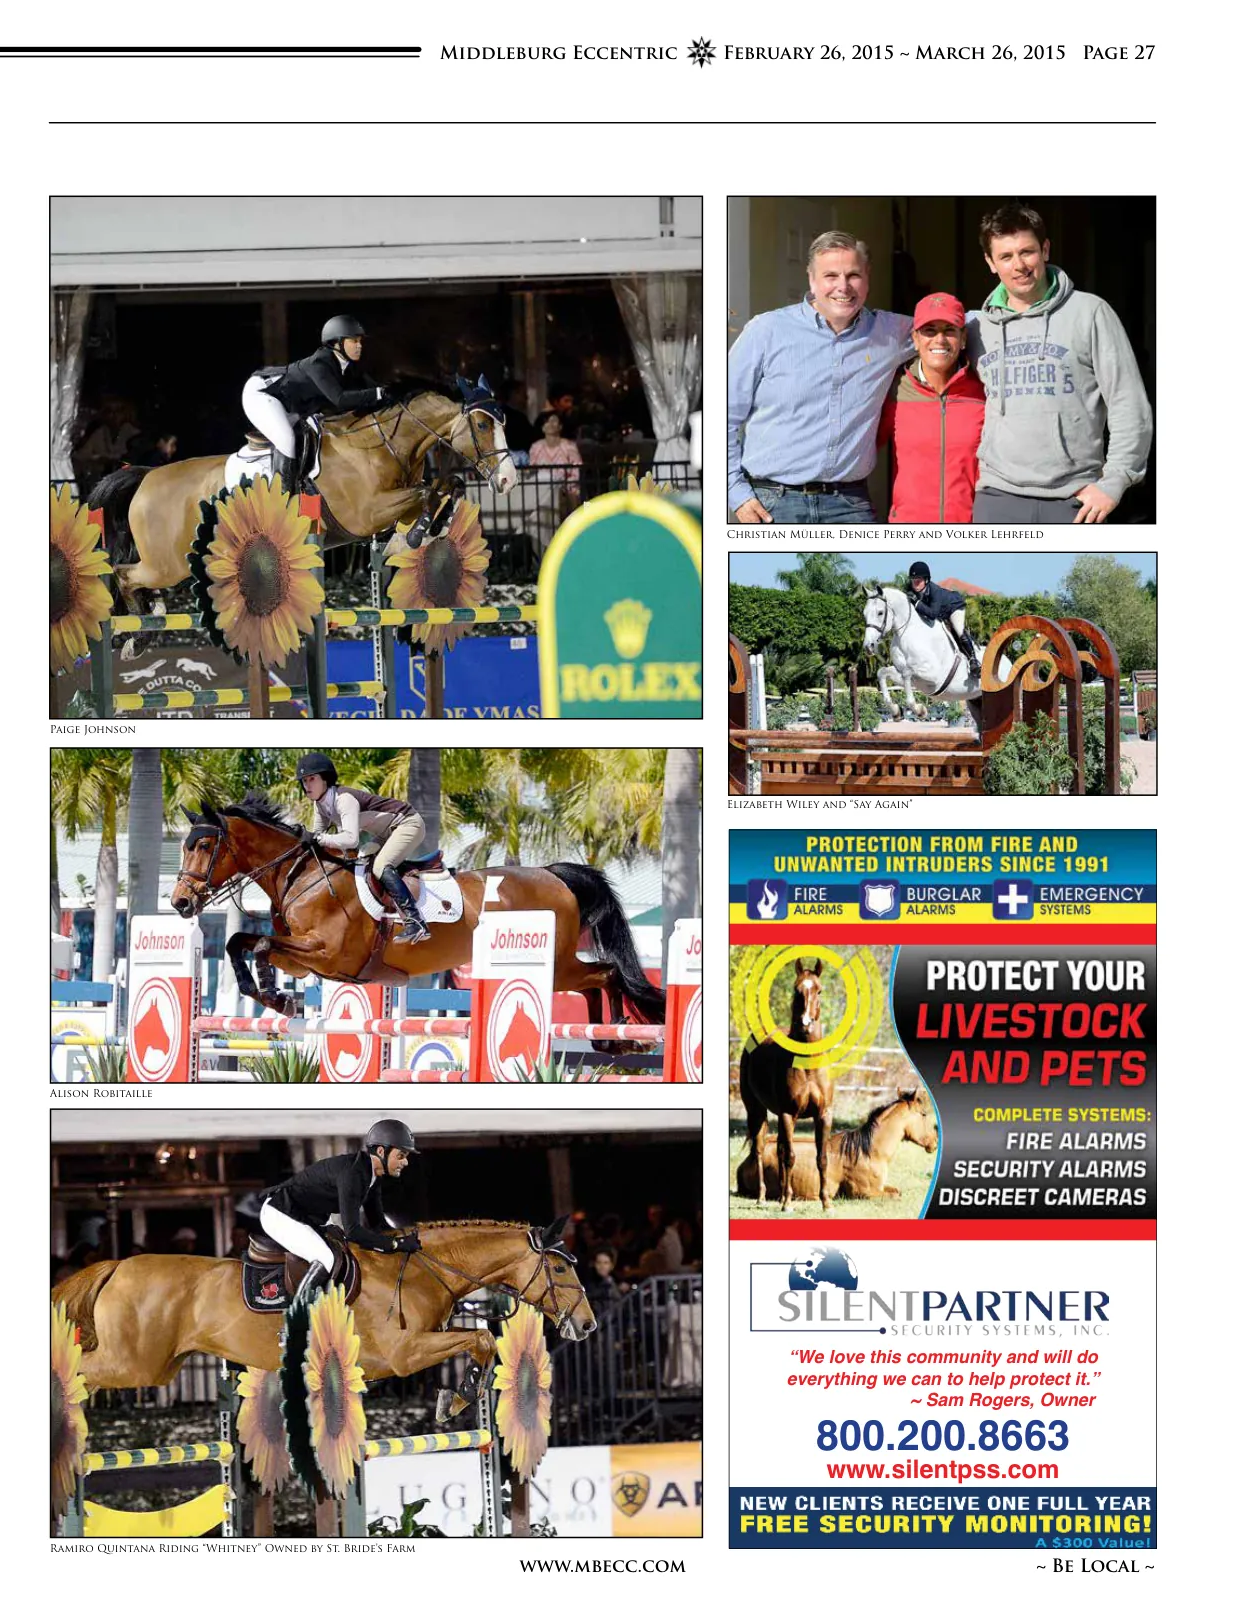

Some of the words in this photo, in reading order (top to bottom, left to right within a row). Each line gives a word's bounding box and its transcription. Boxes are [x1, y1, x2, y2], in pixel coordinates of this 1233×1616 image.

[440, 44, 566, 60] MIDDLEBURG
[573, 44, 678, 60] ECCENTRIC
[724, 44, 816, 60] FEBRUARY
[915, 44, 985, 60] MARCH
[1083, 44, 1129, 60] PAGE
[1134, 44, 1156, 60] 27
[146, 675, 184, 692] DUTTA
[561, 662, 702, 702] ROLEX
[806, 836, 922, 853] PROTECTION
[930, 836, 983, 853] FROM
[991, 836, 1033, 853] FIRE
[1039, 836, 1078, 853] AND
[774, 856, 878, 873] UNWANTED
[886, 856, 993, 873] INTRUDERS
[1000, 856, 1055, 873] SINCE
[1063, 856, 1108, 873] 1991
[794, 887, 827, 901] FIRE
[906, 887, 982, 901] BURGLAR
[1039, 887, 1144, 901] EMERGENCY
[793, 903, 843, 915] ALARMS
[906, 903, 956, 915] ALARMS
[1039, 903, 1091, 915] SYSTEMS
[134, 931, 185, 951] Johnson
[490, 928, 548, 950] Johnson
[927, 960, 1059, 991] PROTECT
[1066, 960, 1145, 991] YOUR
[917, 1003, 1147, 1038] LIVESTOCK
[941, 1050, 1030, 1084] AND
[1040, 1050, 1146, 1086] PETS
[973, 1107, 1063, 1123] COMPLETE
[1068, 1107, 1151, 1123] SYSTEMS:
[1006, 1132, 1054, 1150] FIRE
[1058, 1132, 1147, 1150] ALARMS
[953, 1160, 1055, 1178] SECURITY
[1058, 1160, 1147, 1178] ALARMS
[939, 1188, 1040, 1206] DISCREET
[1044, 1188, 1147, 1206] CAMERAS
[891, 1324, 973, 1336] SECURITY
[982, 1324, 1063, 1337] SYSTEMS,
[1073, 1324, 1110, 1336] INC.
[829, 1349, 866, 1365] love
[870, 1349, 902, 1365] this
[906, 1349, 1003, 1368] community
[1006, 1349, 1040, 1365] and
[1043, 1349, 1074, 1364] will
[1076, 1349, 1099, 1365] do
[786, 1371, 878, 1390] everything
[883, 1374, 907, 1387] we
[910, 1374, 943, 1387] can
[947, 1372, 964, 1387] to
[968, 1371, 1006, 1390] help
[1009, 1372, 1072, 1390] protect
[926, 1391, 965, 1408] Sam
[968, 1392, 1035, 1411] Rogers,
[1040, 1391, 1098, 1408] Owner
[816, 1419, 1070, 1452] 800.200.8663
[826, 1458, 1059, 1485] www.silentpss.com
[740, 1496, 787, 1511] NEW
[795, 1495, 884, 1511] CLIENTS
[892, 1495, 980, 1511] RECEIVE
[987, 1495, 1030, 1511] ONE
[1037, 1496, 1089, 1511] FULL
[1095, 1496, 1151, 1511] YEAR
[740, 1515, 809, 1533] FREE
[819, 1514, 954, 1534] SECURITY
[965, 1514, 1151, 1534] MONITORING!
[1052, 1536, 1093, 1549] $300
[1097, 1537, 1151, 1549] Value!
[1052, 1557, 1074, 1573] BE
[1081, 1557, 1140, 1573] LOCAL
